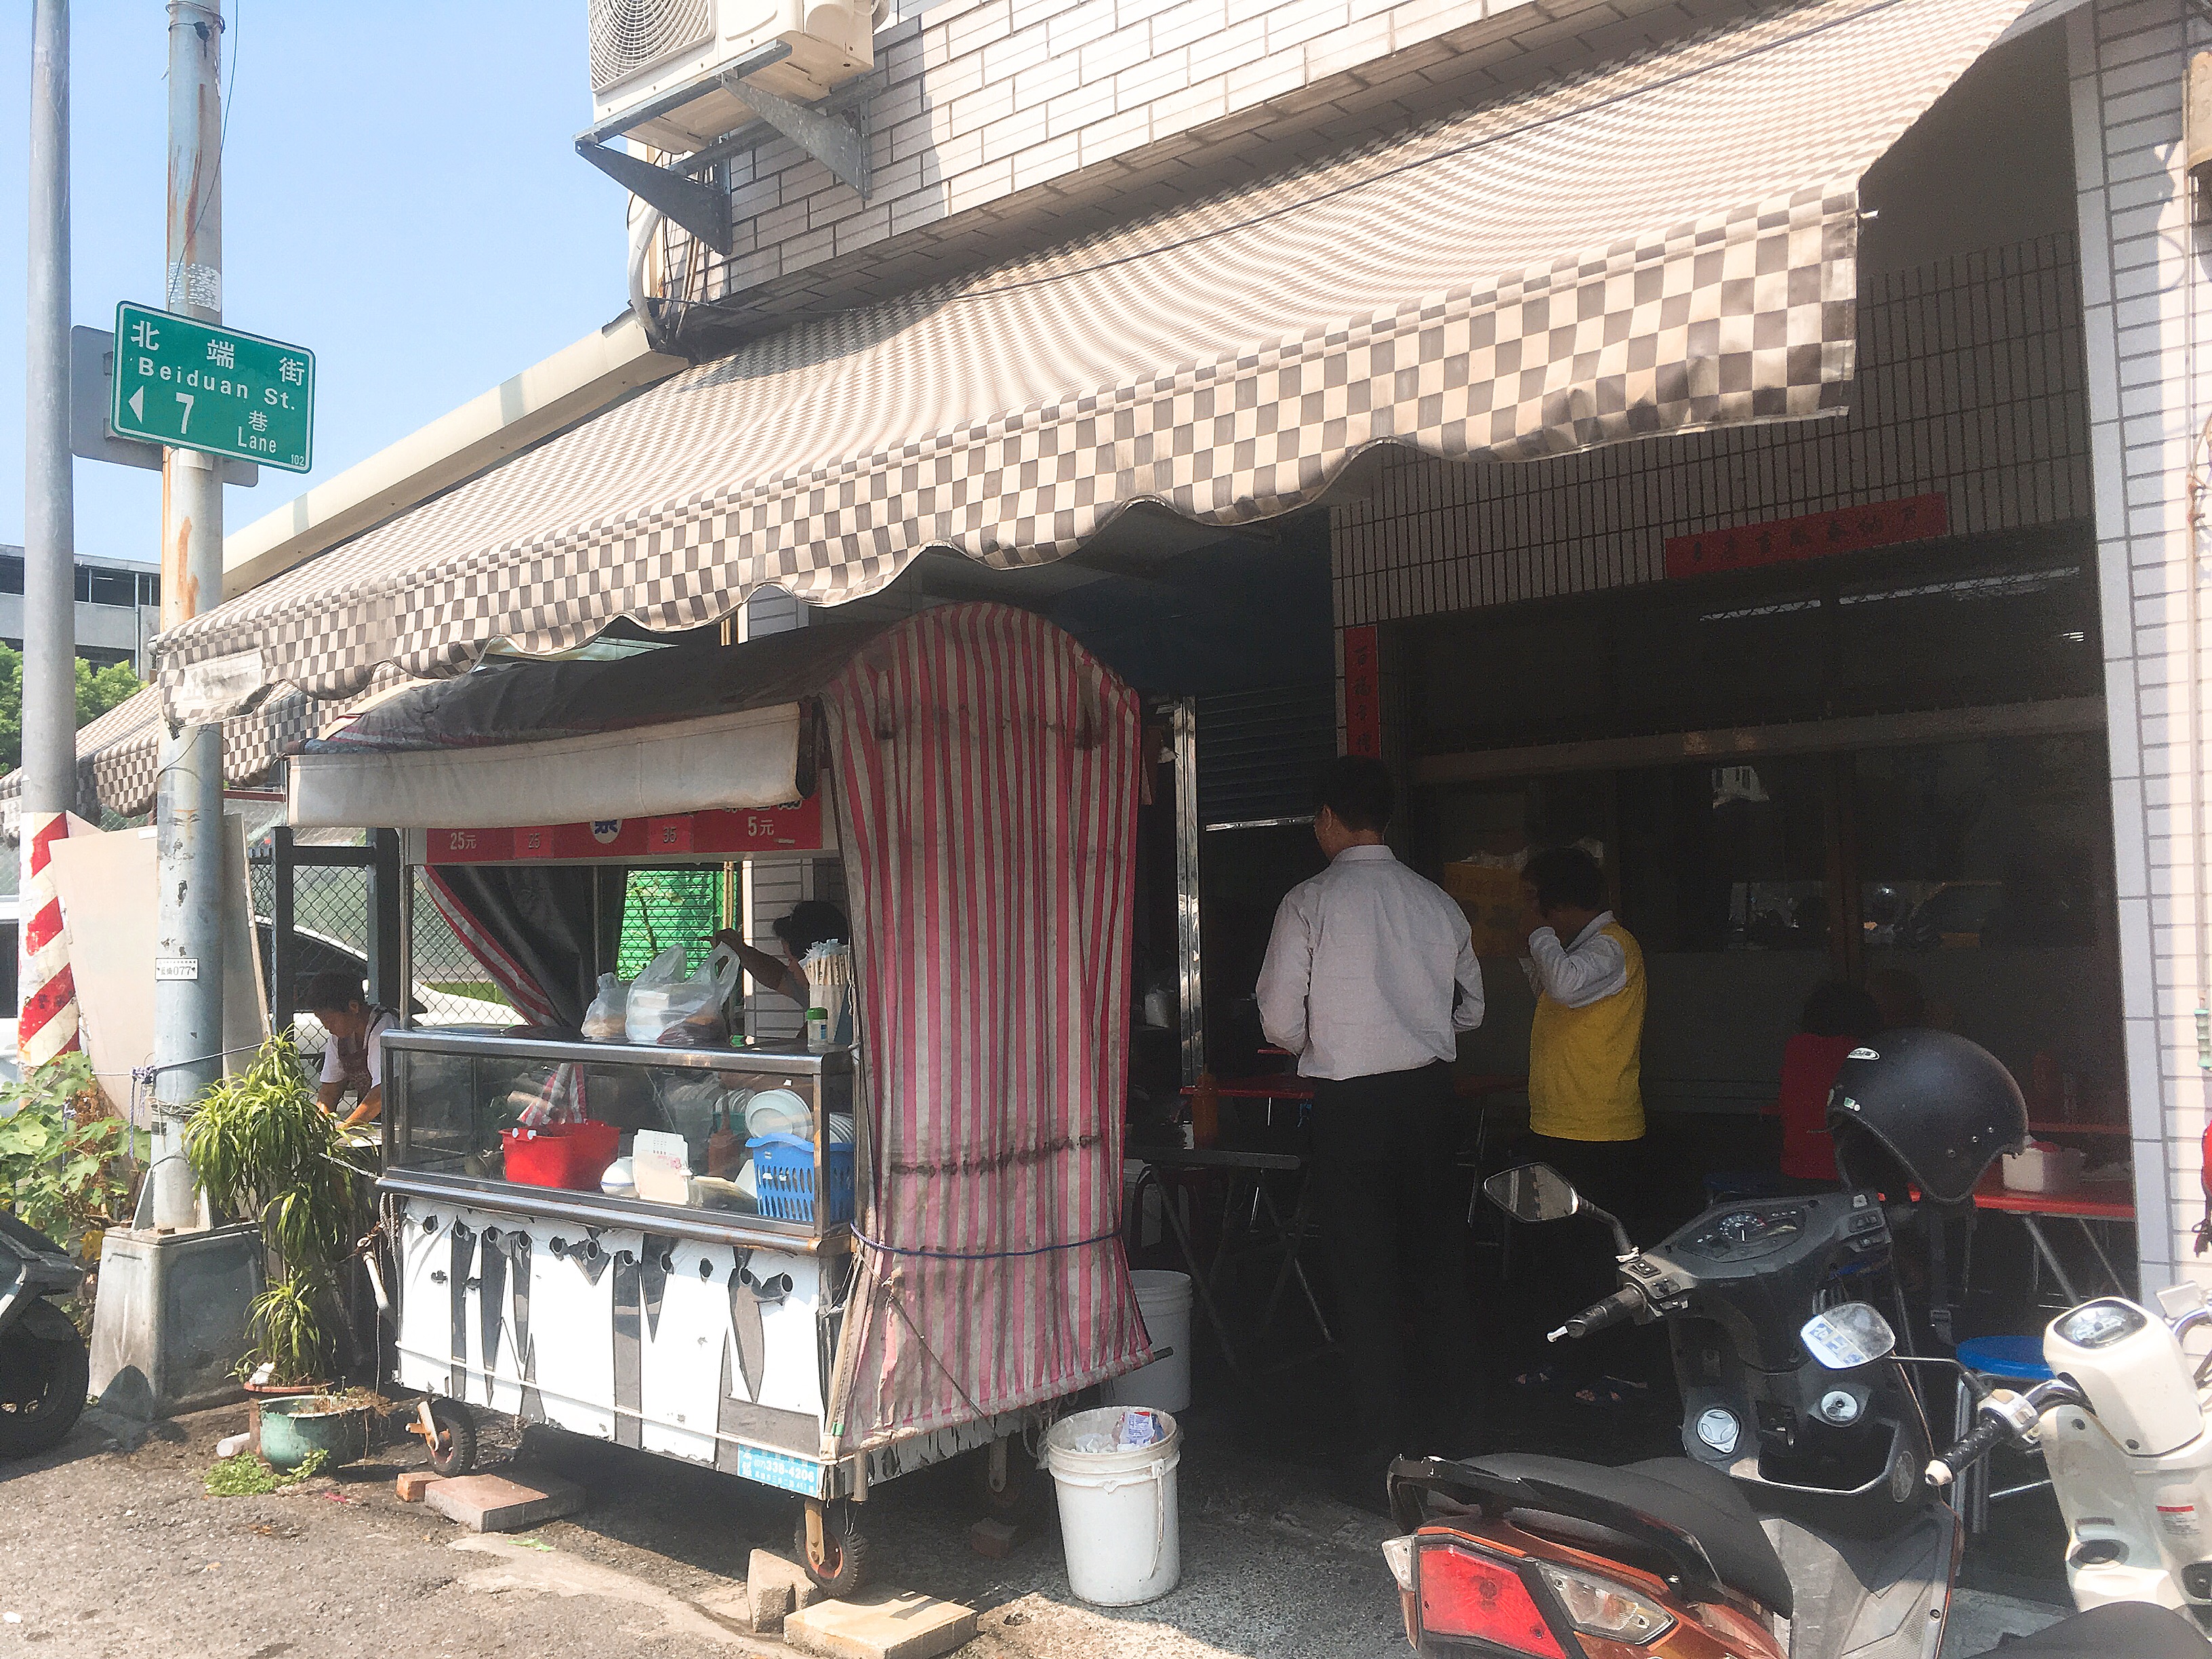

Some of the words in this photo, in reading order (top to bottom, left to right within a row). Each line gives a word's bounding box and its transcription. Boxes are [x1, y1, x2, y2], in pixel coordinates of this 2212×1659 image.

[131, 320, 305, 386] 北端街
[138, 356, 249, 398] Beiduan
[264, 388, 295, 410] St.
[176, 392, 194, 434] 7
[248, 409, 268, 432] 巷
[238, 426, 276, 453] Lane
[291, 453, 304, 466] 102
[747, 816, 775, 837] 5元
[450, 831, 477, 851] 25元
[754, 1458, 815, 1483] (07)338-4206
